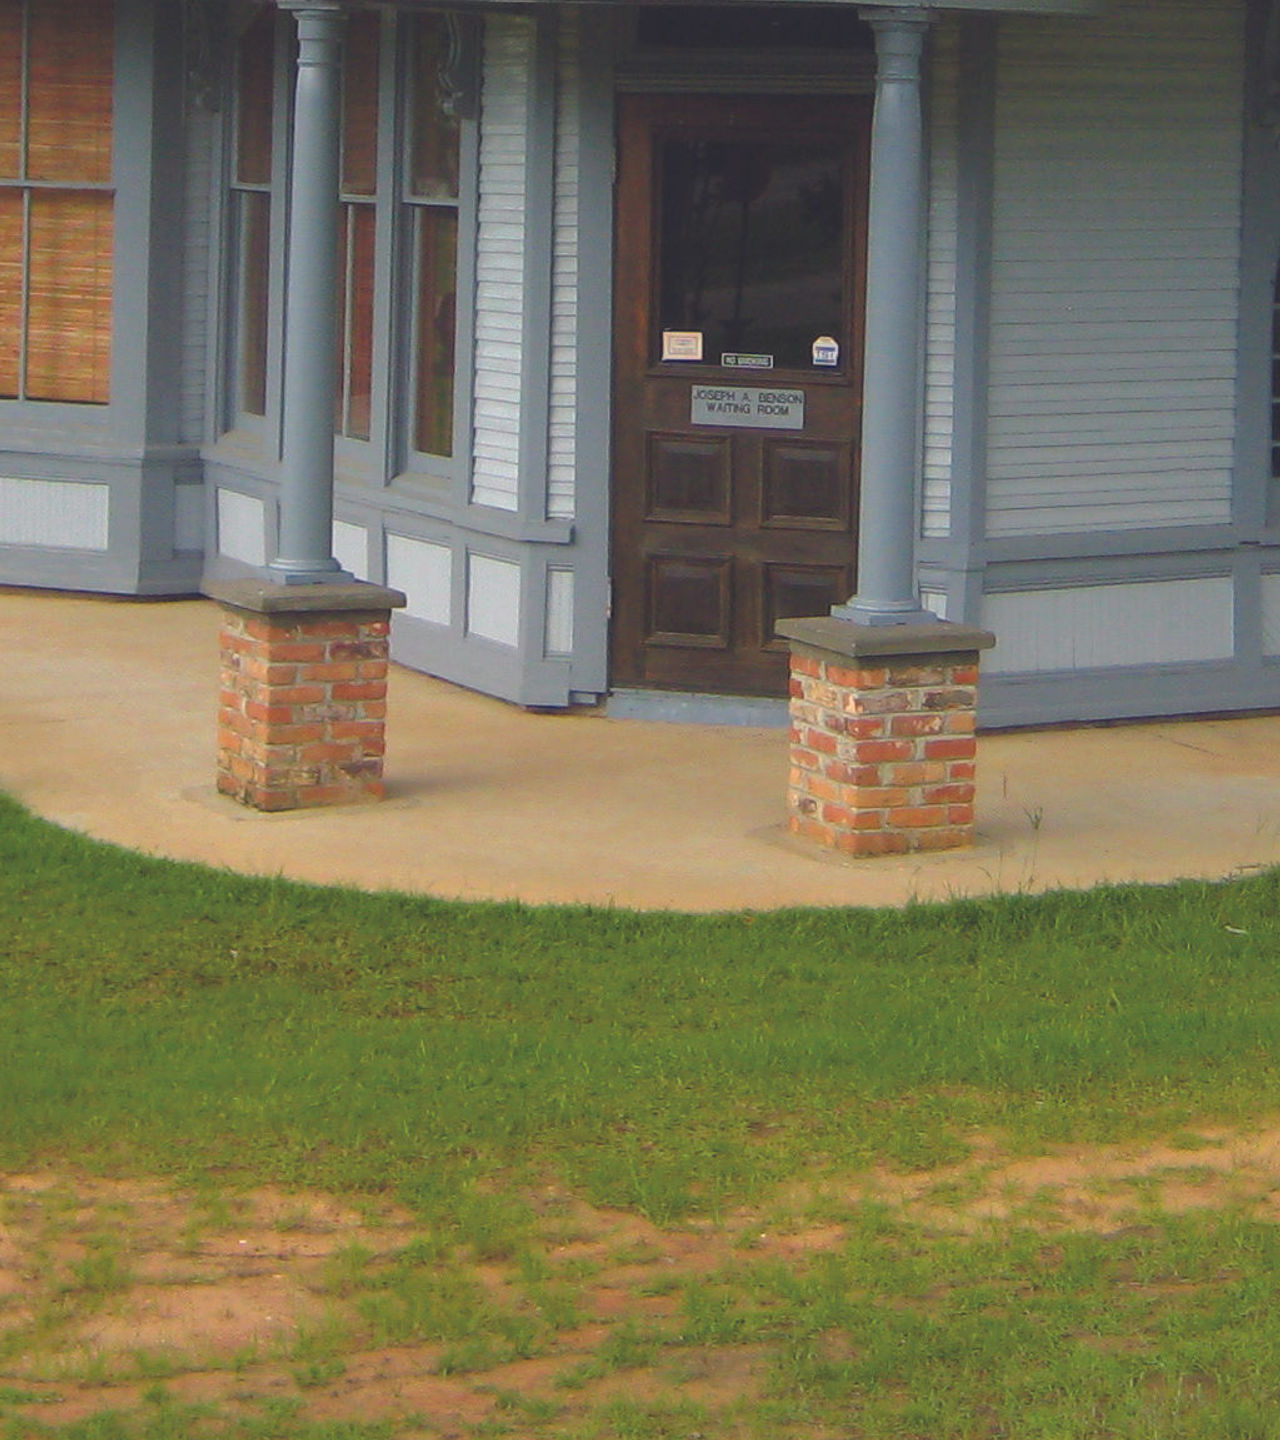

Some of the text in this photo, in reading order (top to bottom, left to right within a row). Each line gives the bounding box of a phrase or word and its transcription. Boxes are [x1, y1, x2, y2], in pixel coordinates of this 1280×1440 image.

[693, 389, 736, 401] JOSEPH
[758, 392, 803, 404] BENSON
[706, 402, 790, 416] WAITING ROOM
